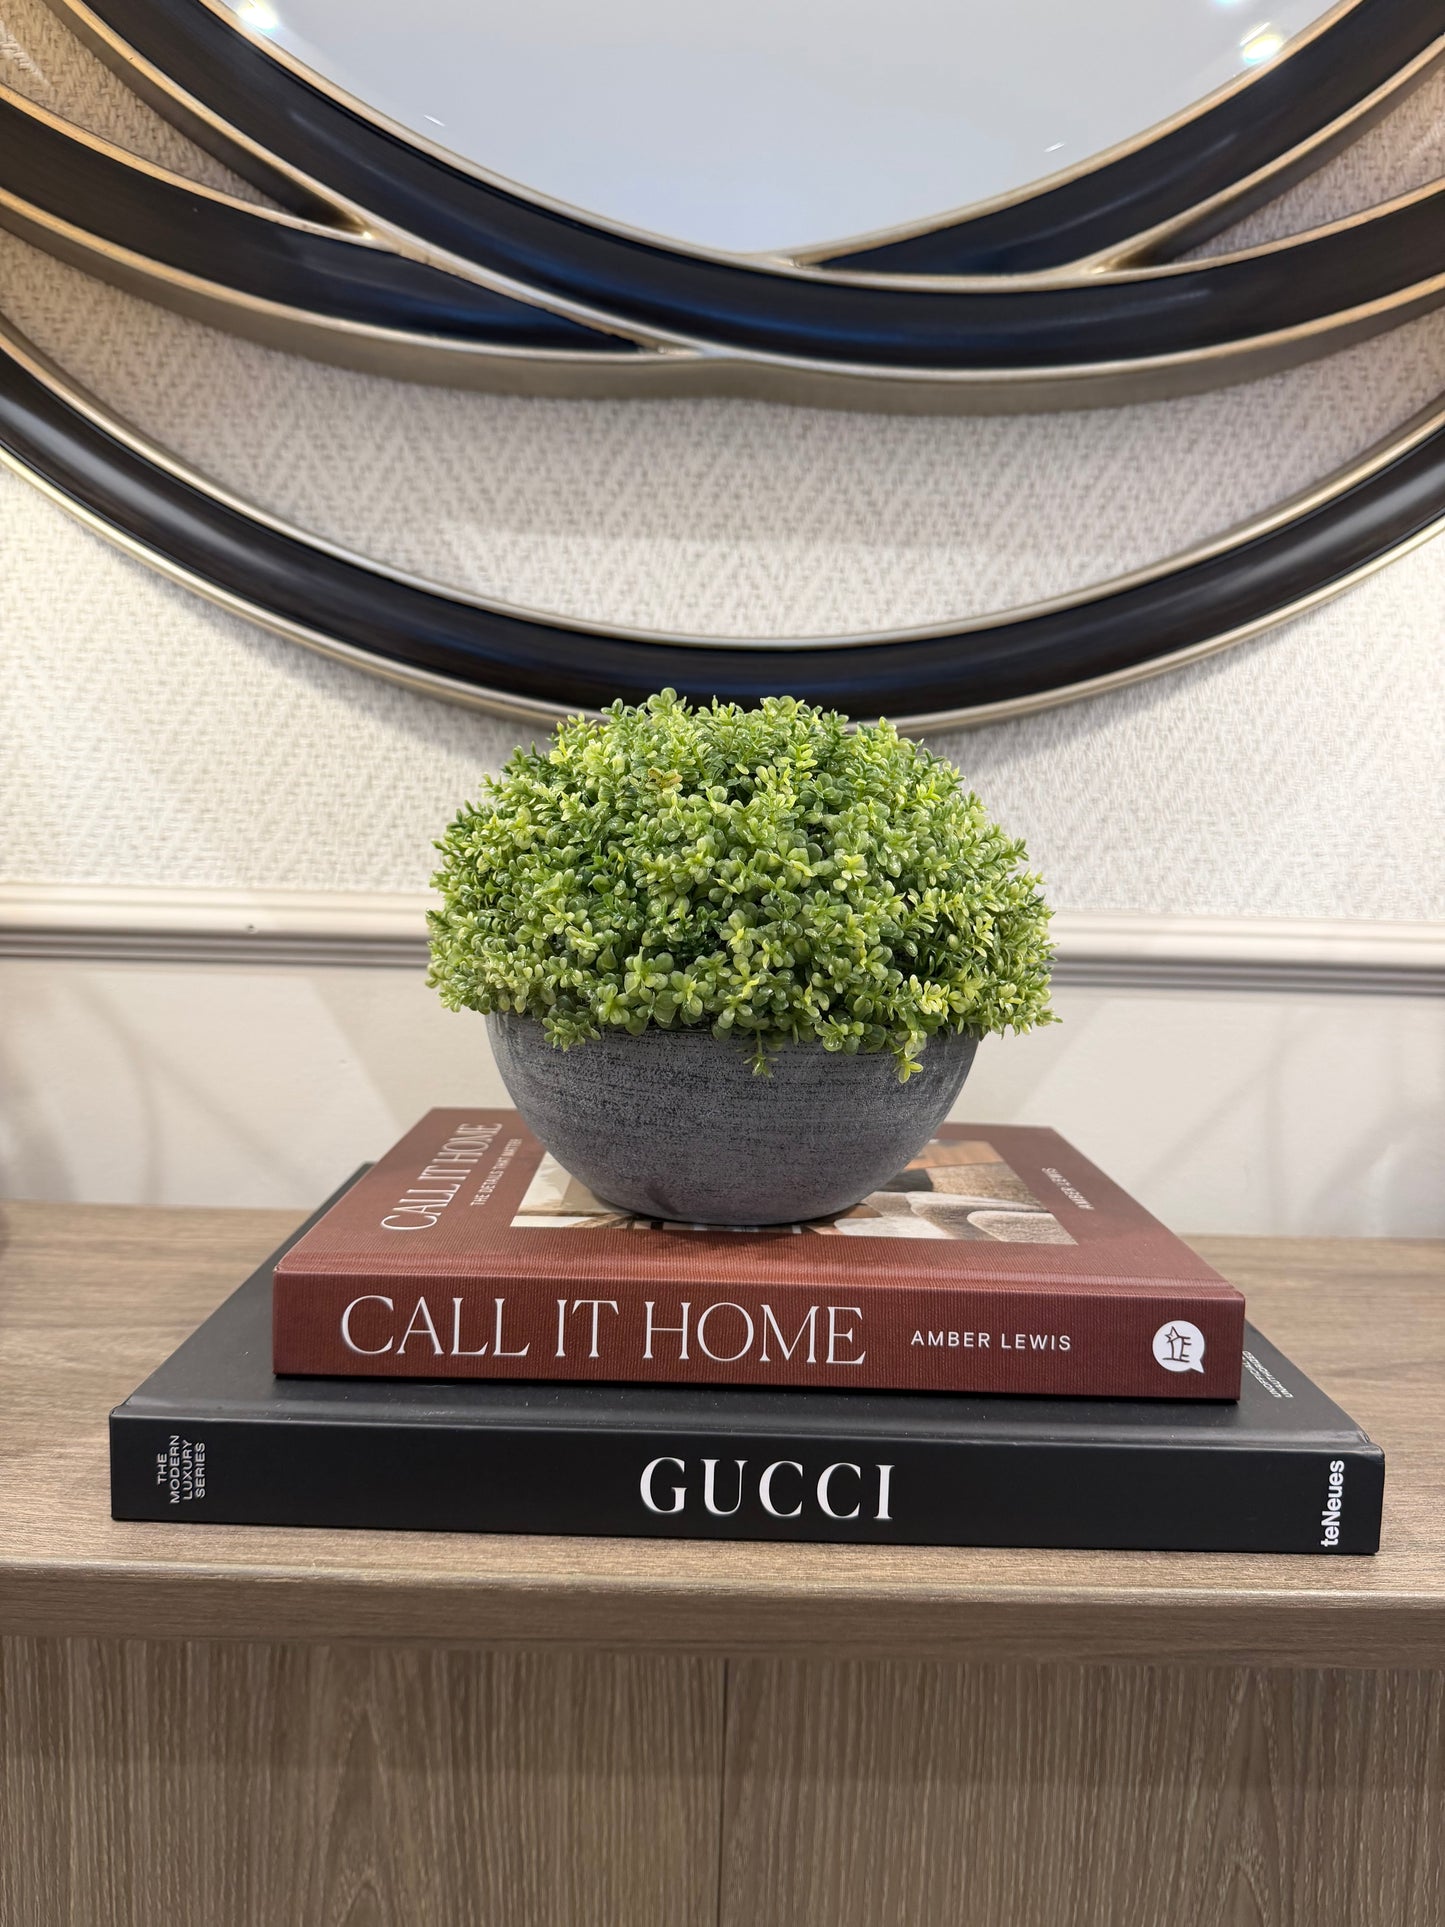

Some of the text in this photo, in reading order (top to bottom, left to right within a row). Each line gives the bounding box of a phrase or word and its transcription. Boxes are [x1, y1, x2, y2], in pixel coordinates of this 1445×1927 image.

[380, 1123, 503, 1231] CALL IT HOME
[470, 1194, 491, 1206] THE
[341, 1295, 867, 1365] CALL IT HOME
[910, 1330, 1072, 1351] AMBER LEWIS
[157, 1453, 168, 1485] THE
[169, 1435, 180, 1504] MODERN
[182, 1440, 193, 1500] LUXURY
[195, 1442, 206, 1498] SERIES
[640, 1456, 895, 1520] GUCCI
[1320, 1460, 1345, 1547] teNeues
